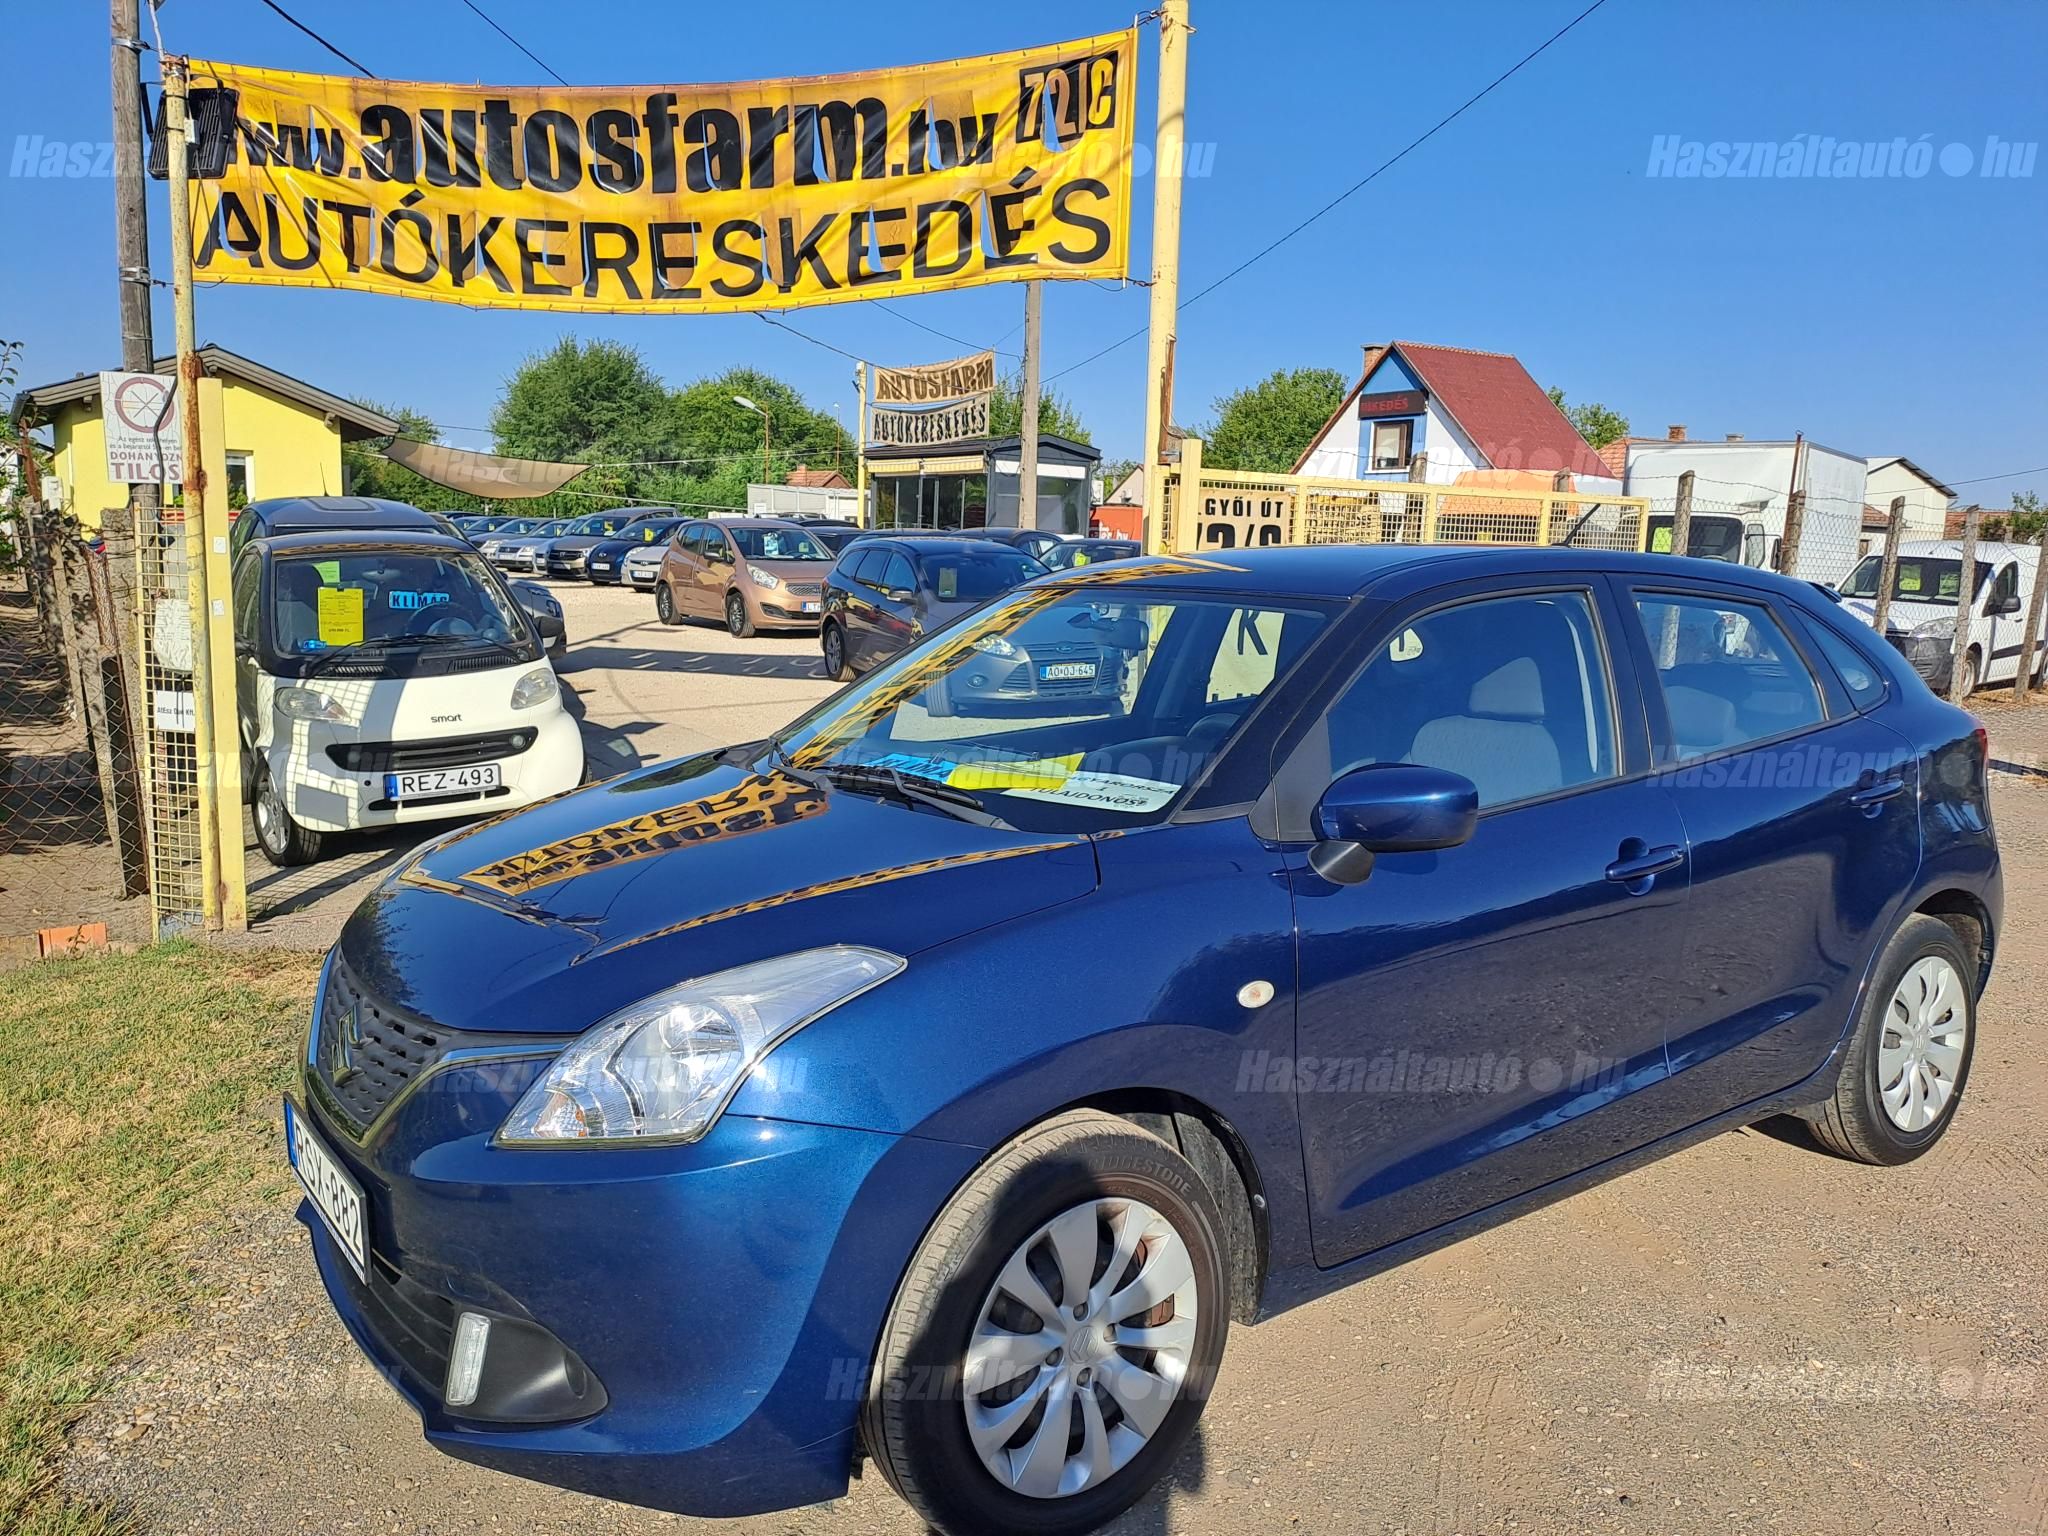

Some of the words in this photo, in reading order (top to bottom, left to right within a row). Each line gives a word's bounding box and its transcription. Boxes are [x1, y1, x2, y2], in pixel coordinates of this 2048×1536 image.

[218, 92, 999, 195] ww.autosfarm.hu
[195, 166, 1110, 300] AUTÓKERESKEDÉS
[110, 462, 180, 481] TILOS
[1197, 496, 1252, 517] GYŐI
[1261, 497, 1284, 518] ÚT
[430, 713, 463, 723] smart
[401, 767, 495, 793] REZ-493
[294, 1121, 362, 1257] RSX-882
